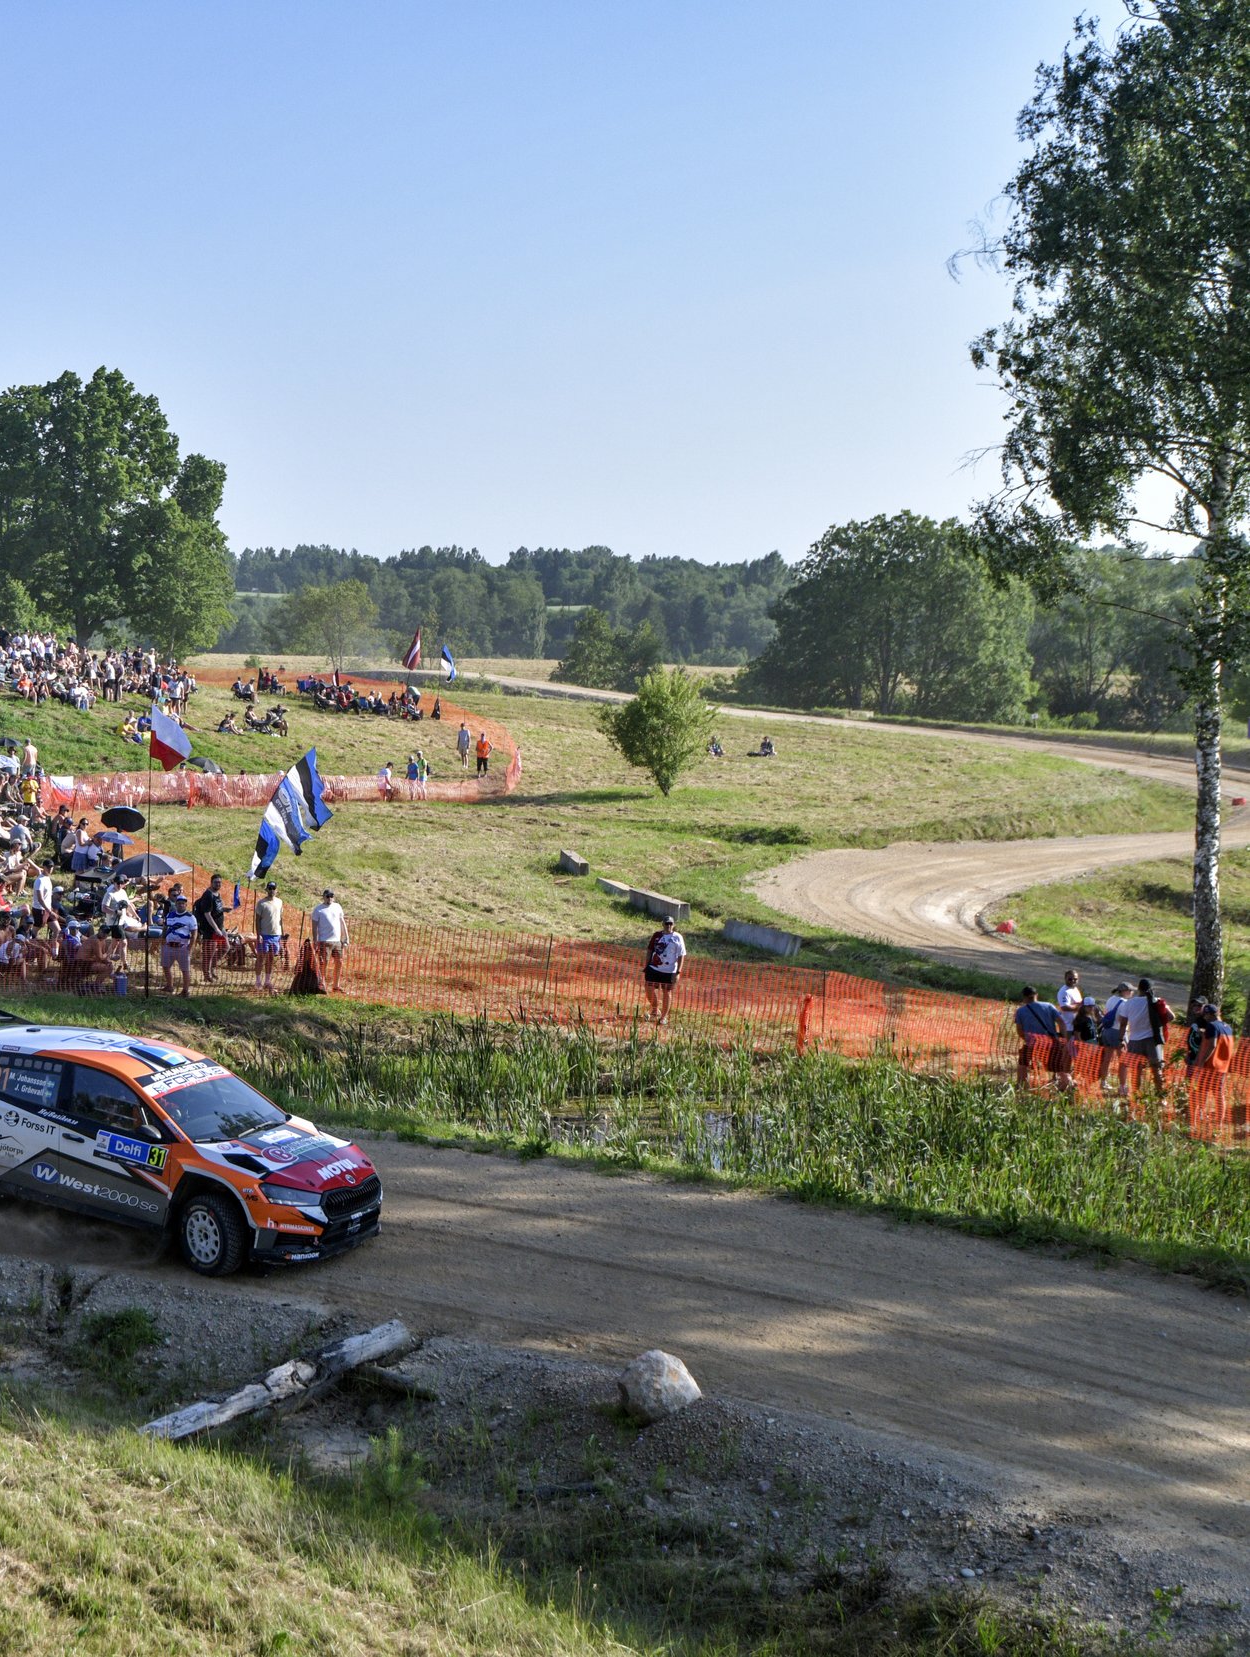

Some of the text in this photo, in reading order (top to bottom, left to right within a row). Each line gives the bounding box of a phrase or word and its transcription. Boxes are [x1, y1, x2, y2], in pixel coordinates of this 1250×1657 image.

[9, 1071, 17, 1081] M.
[17, 1073, 48, 1087] Johansson
[14, 1083, 20, 1092] J.
[21, 1117, 57, 1136] Forss IT
[114, 1140, 166, 1168] Delfi 31
[317, 1158, 358, 1180] MOTUL
[59, 1173, 159, 1213] West2000.se
